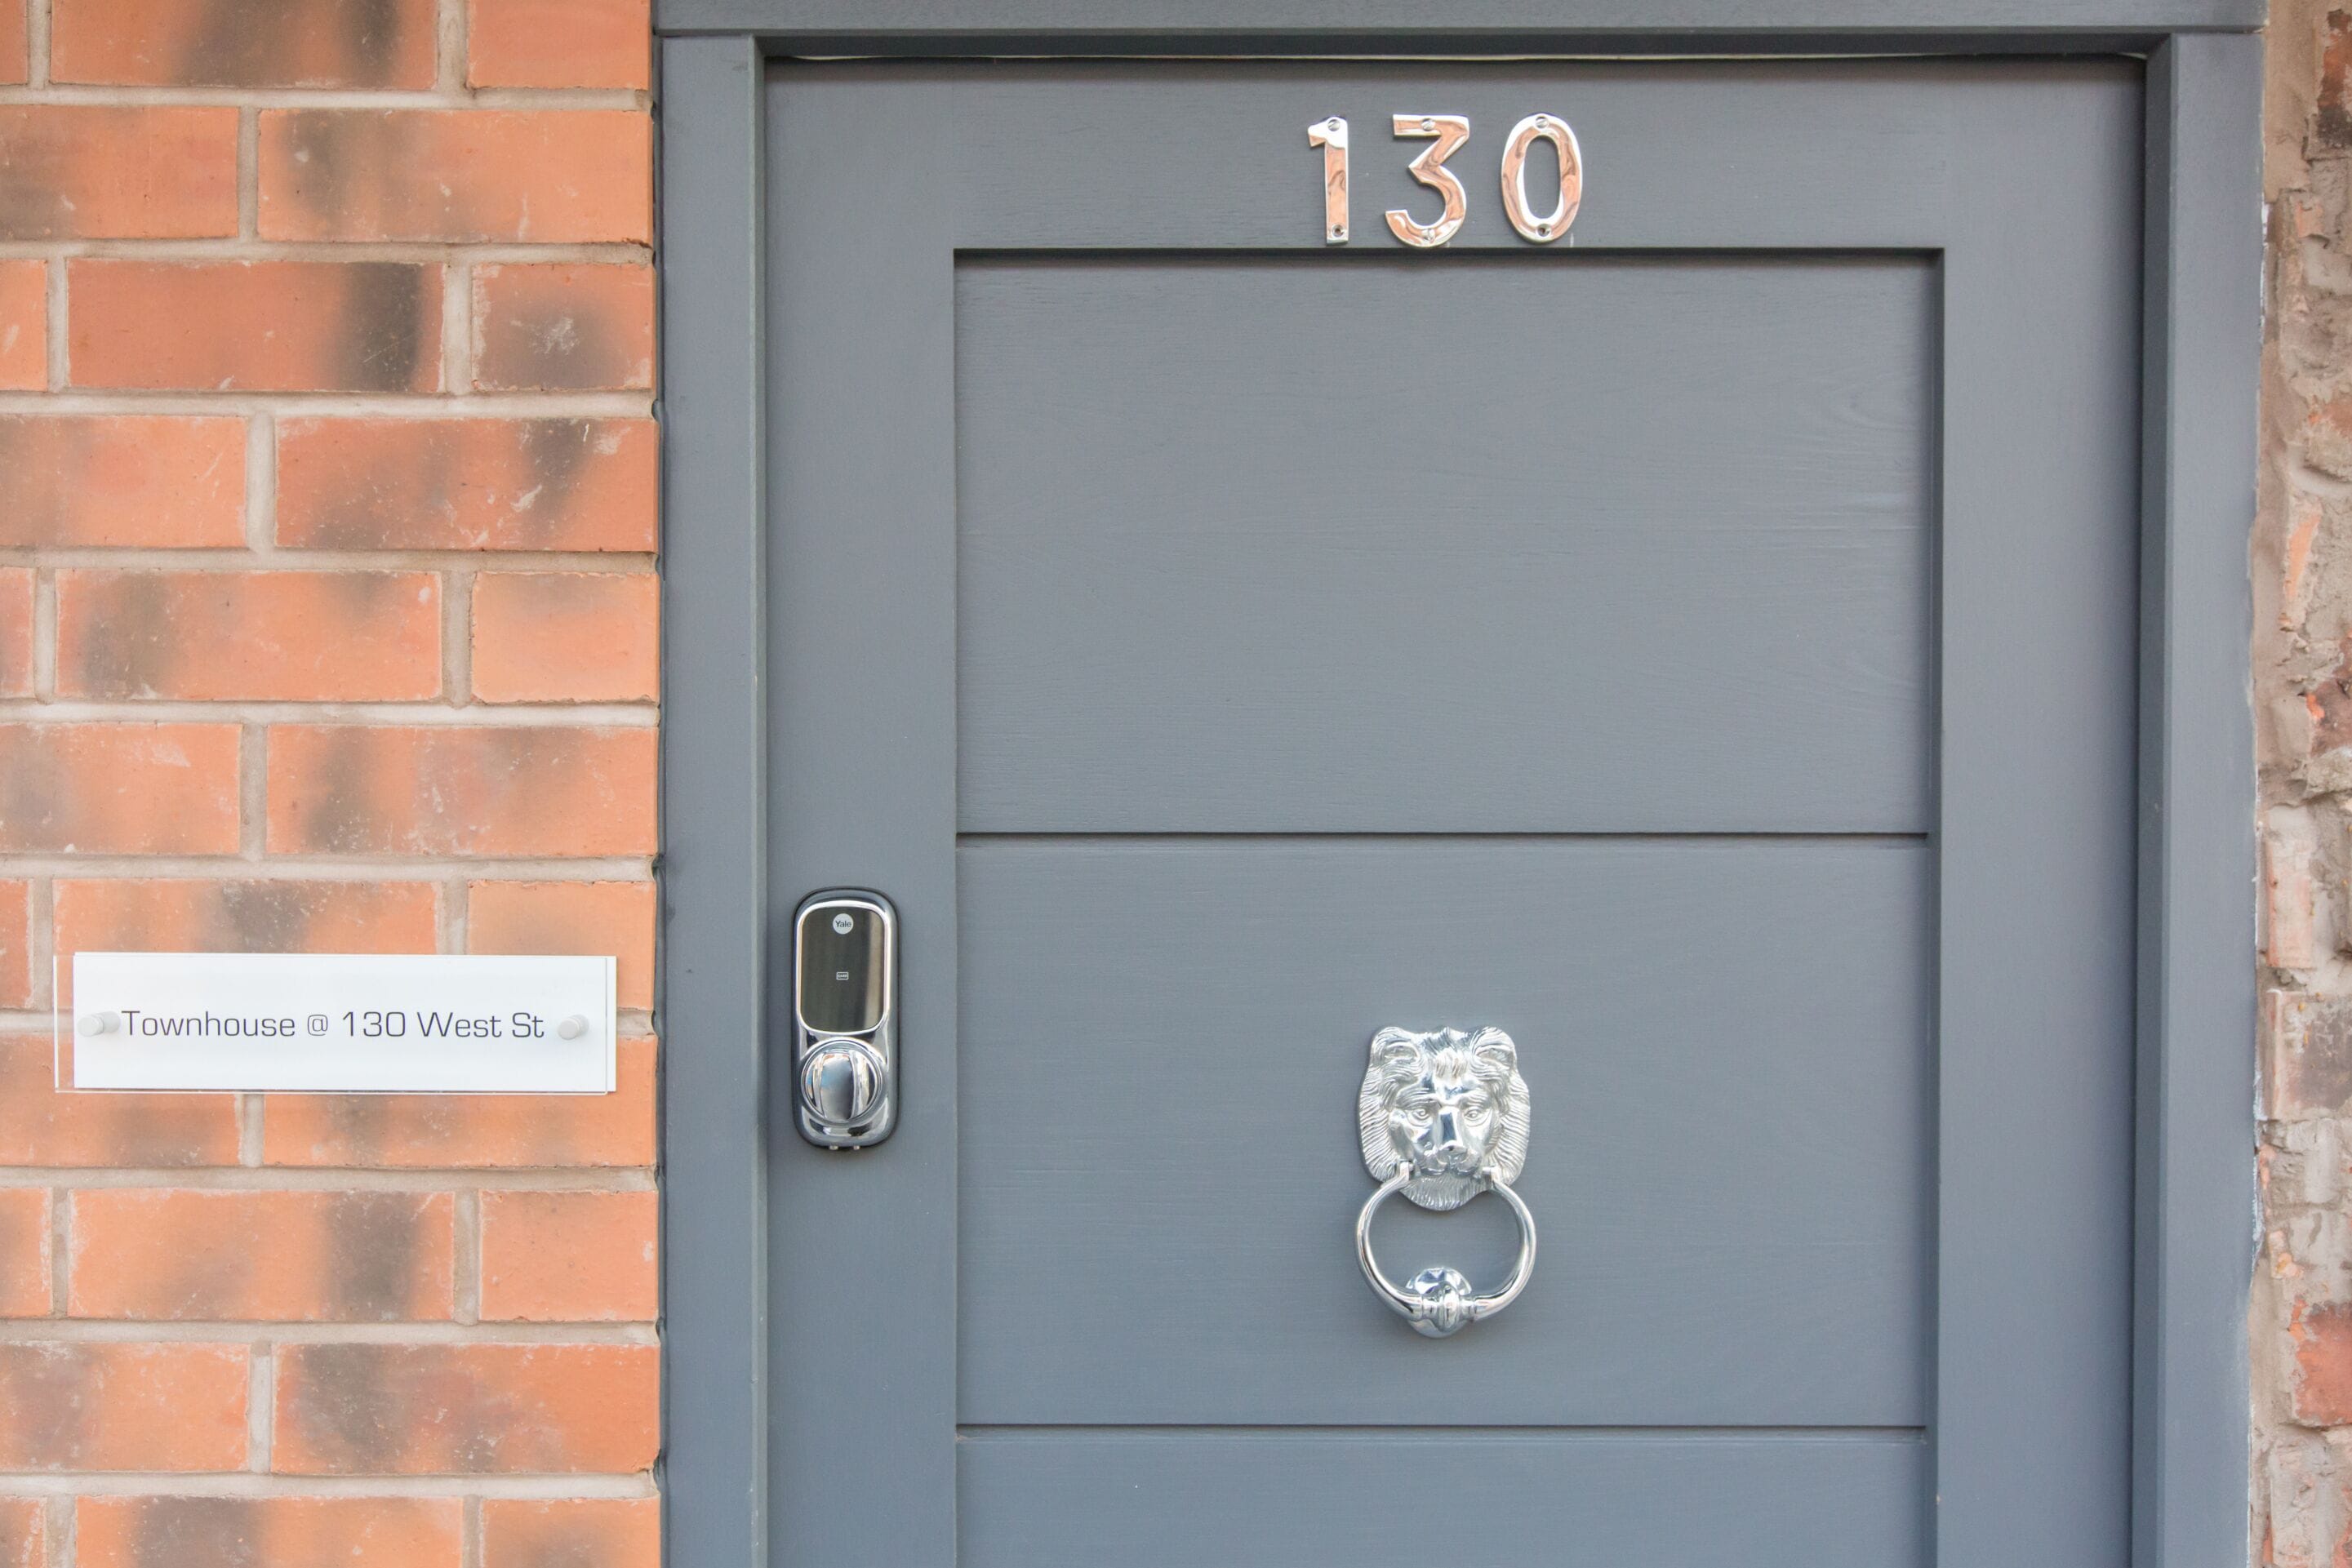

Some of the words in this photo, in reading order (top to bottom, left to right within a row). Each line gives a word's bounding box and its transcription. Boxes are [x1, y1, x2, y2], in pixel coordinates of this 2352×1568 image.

[1307, 113, 1583, 247] 130
[121, 1011, 296, 1037] Townhouse
[307, 1014, 328, 1037] @
[342, 1011, 406, 1037] 130
[416, 1011, 502, 1038] West
[512, 1012, 545, 1038] St
